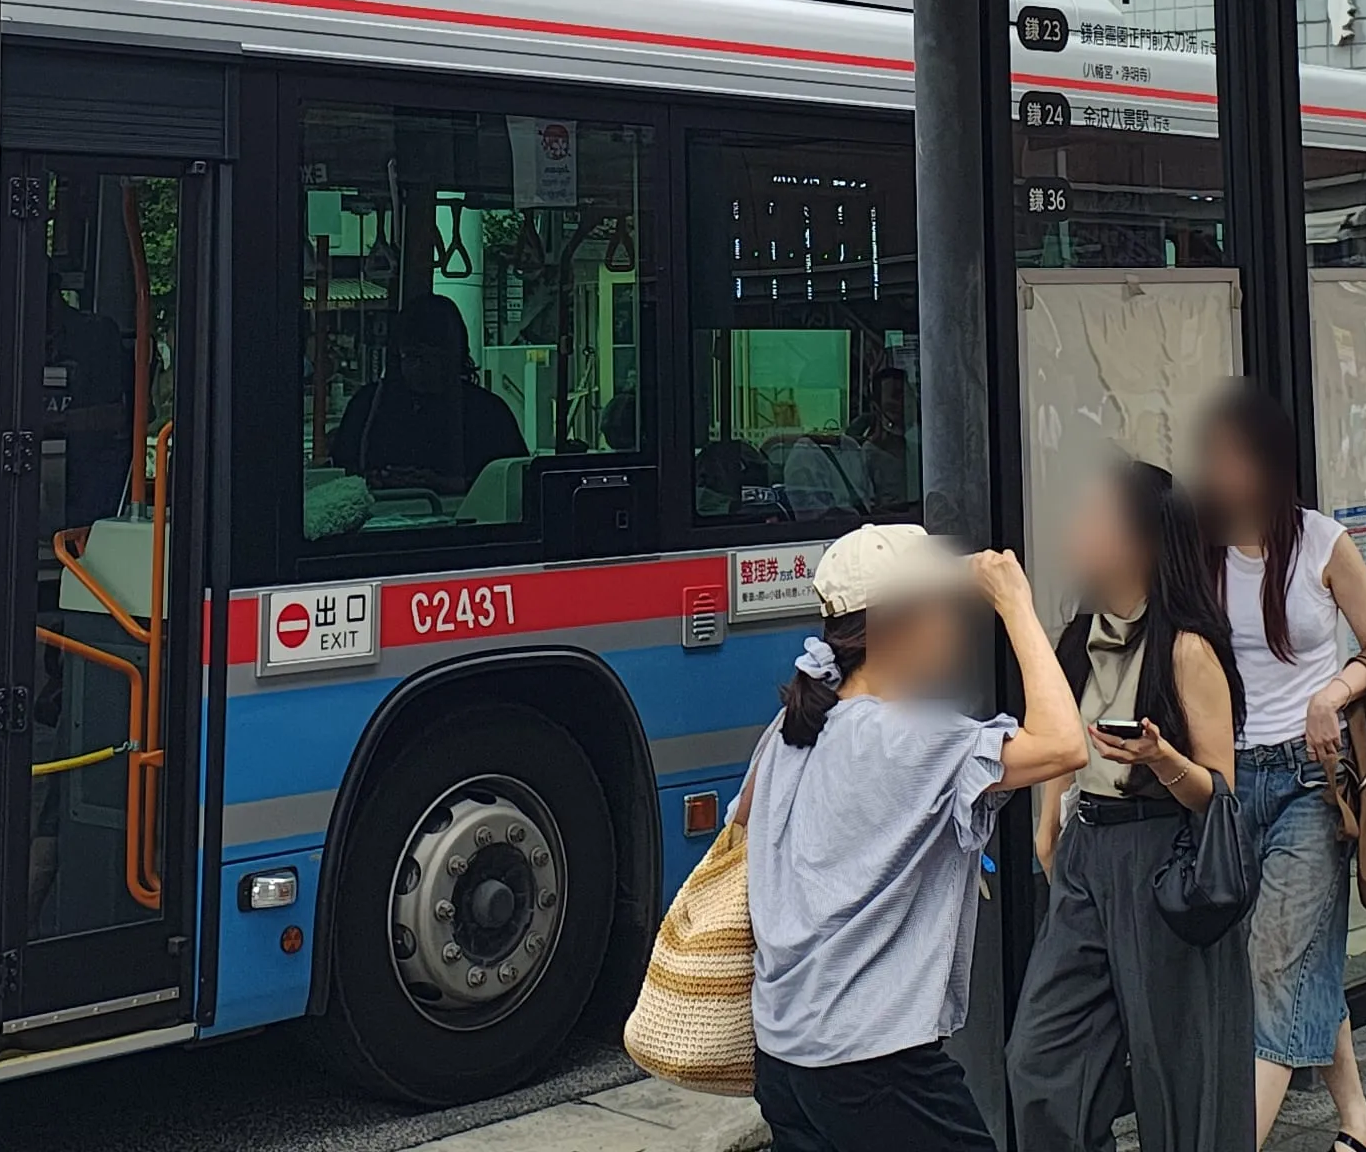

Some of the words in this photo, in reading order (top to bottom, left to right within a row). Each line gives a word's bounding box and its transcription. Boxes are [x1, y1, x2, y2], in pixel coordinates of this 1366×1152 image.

[315, 594, 366, 627] 出口
[410, 584, 515, 634] C2437
[320, 630, 359, 651] EXIT
